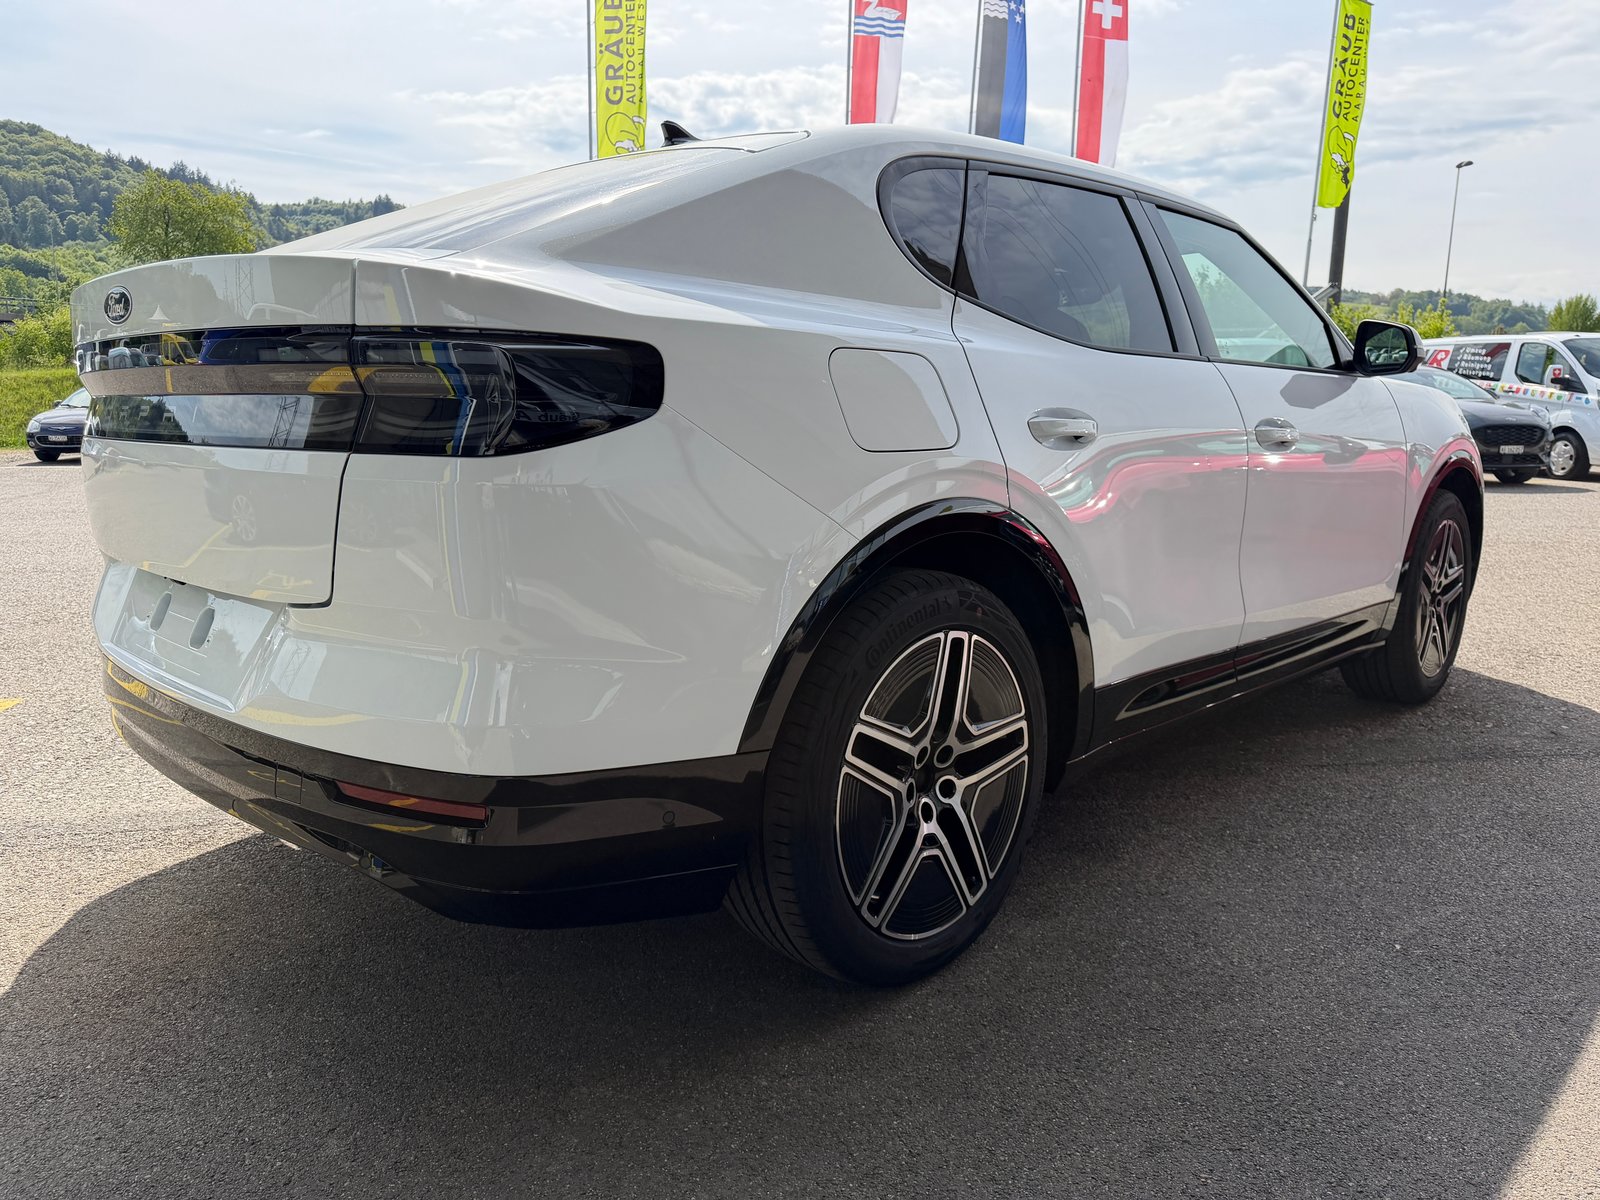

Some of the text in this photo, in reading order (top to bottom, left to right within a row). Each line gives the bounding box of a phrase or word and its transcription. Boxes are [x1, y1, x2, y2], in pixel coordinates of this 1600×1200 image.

[625, 0, 637, 105] AUTOCENTE
[1332, 13, 1357, 119] GRÄUB
[1342, 17, 1365, 122] AUTOCENTER
[1351, 69, 1366, 122] AARAU
[107, 293, 125, 317] Ford
[1458, 368, 1494, 378] Entsorgung
[1460, 360, 1492, 370] Reinigung
[865, 598, 940, 671] Continental
